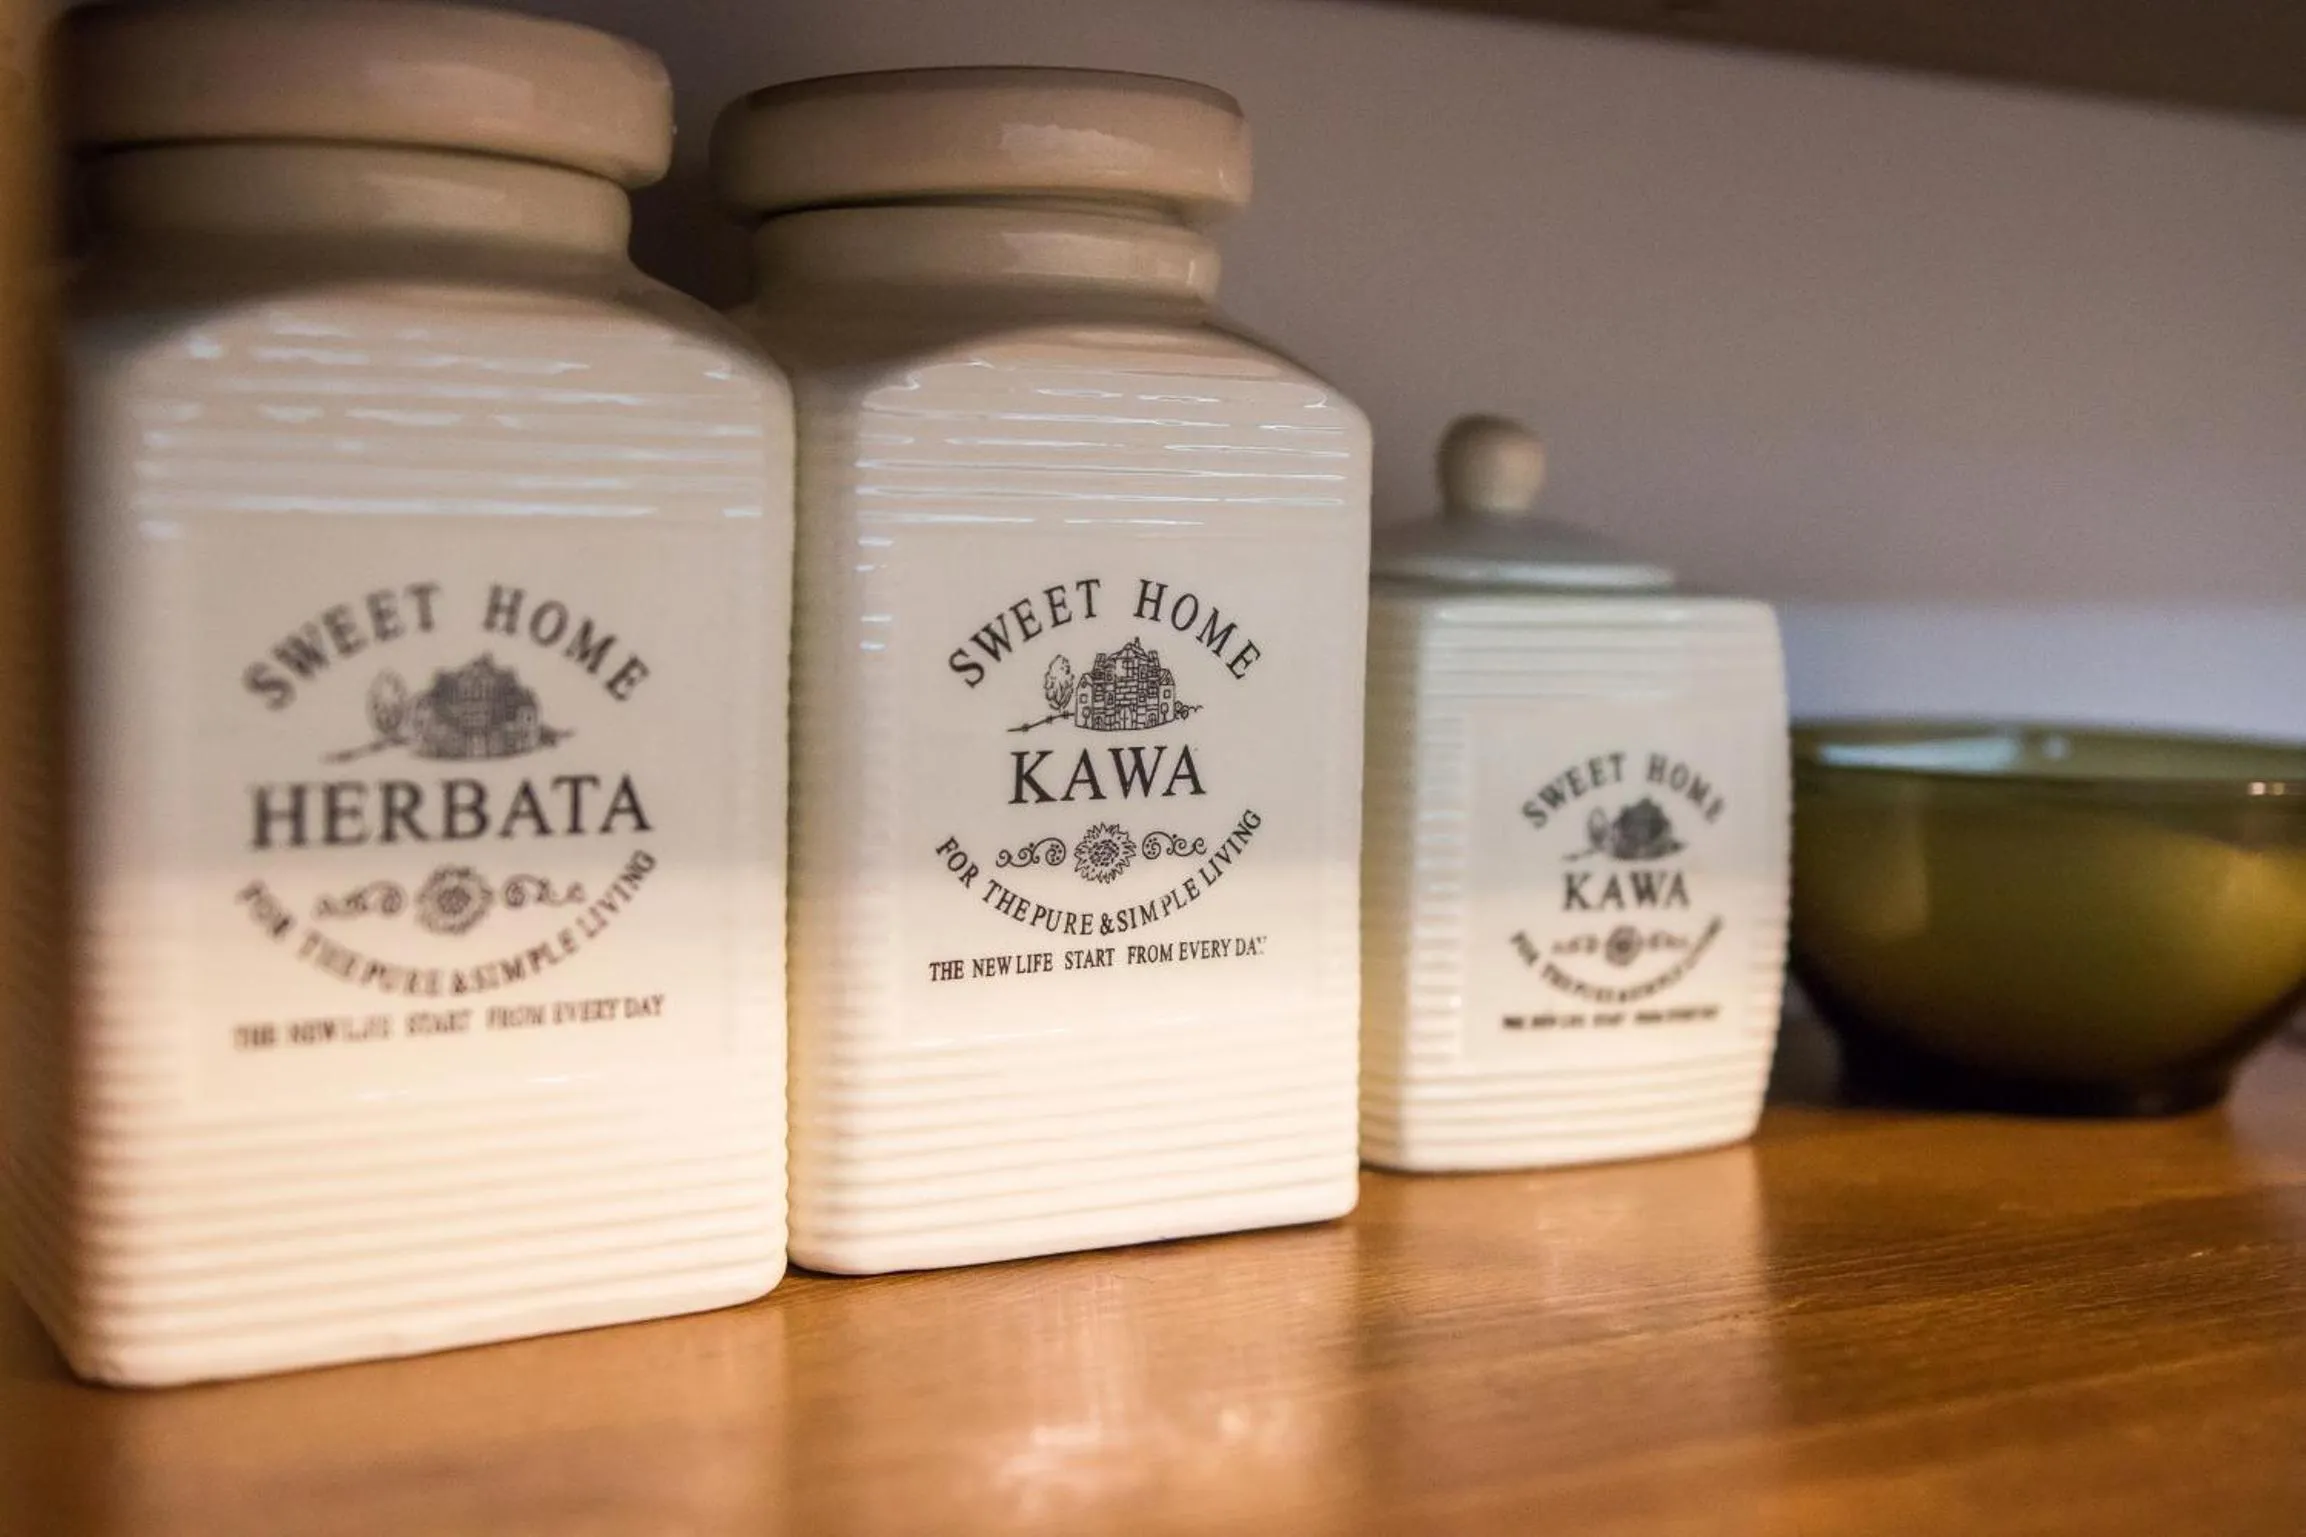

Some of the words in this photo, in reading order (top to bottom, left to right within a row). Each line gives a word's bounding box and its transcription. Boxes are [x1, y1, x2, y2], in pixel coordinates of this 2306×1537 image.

[242, 581, 441, 711] SWEET
[481, 584, 651, 702] HOME
[948, 578, 1101, 688] SWEET
[1133, 579, 1261, 680] HOME
[248, 772, 654, 852] HERBATA
[1008, 744, 1206, 804] KAWA
[1520, 752, 1625, 832] SWEET
[935, 836, 981, 889] FOR
[981, 879, 1031, 922] THE
[1029, 904, 1094, 935] PURE
[1199, 808, 1262, 887] LIVING
[1562, 869, 1690, 912] KAWA
[929, 959, 965, 982] THE
[972, 955, 1012, 979] NEW
[1015, 952, 1053, 975] LIFE
[1064, 947, 1116, 971] START
[1127, 942, 1173, 965] FROM
[1178, 938, 1232, 962] EVERY
[623, 994, 666, 1019] DAY
